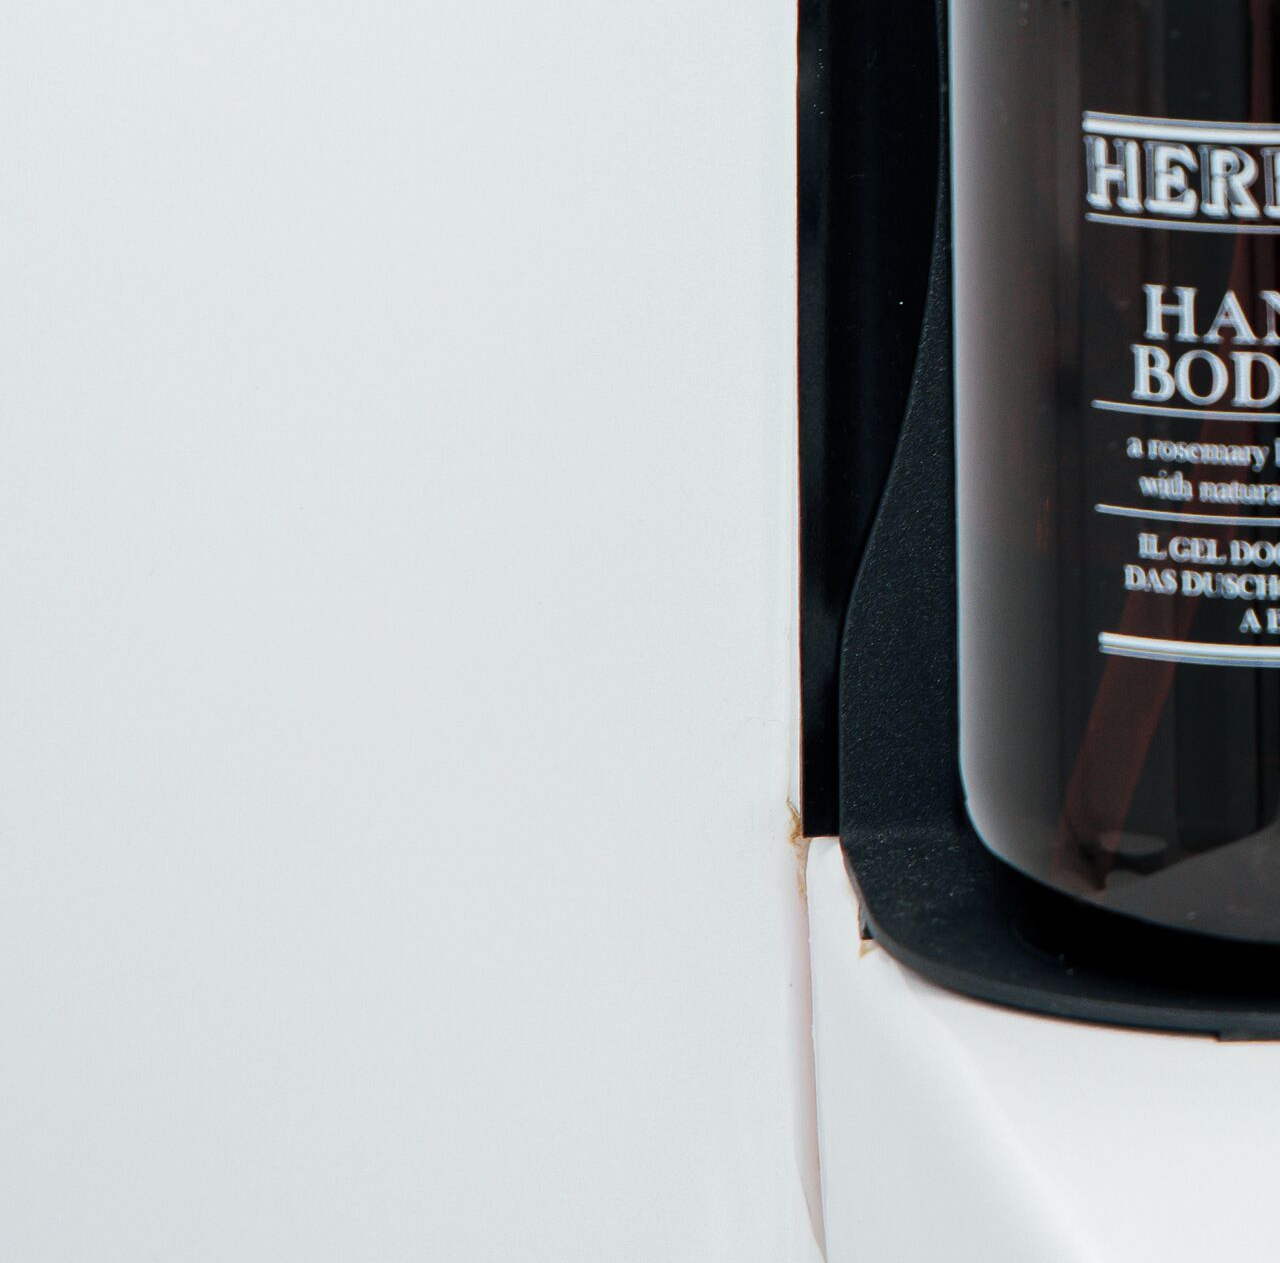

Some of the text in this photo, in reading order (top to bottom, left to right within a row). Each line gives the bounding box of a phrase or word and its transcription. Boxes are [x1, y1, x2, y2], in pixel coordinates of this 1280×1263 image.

[1127, 437, 1143, 458] a
[1148, 438, 1270, 471] rosemary
[1138, 469, 1193, 502] with
[1138, 533, 1166, 561] IL
[1168, 537, 1226, 565] GEL
[1124, 564, 1178, 595] DAS
[1240, 609, 1260, 634] A
